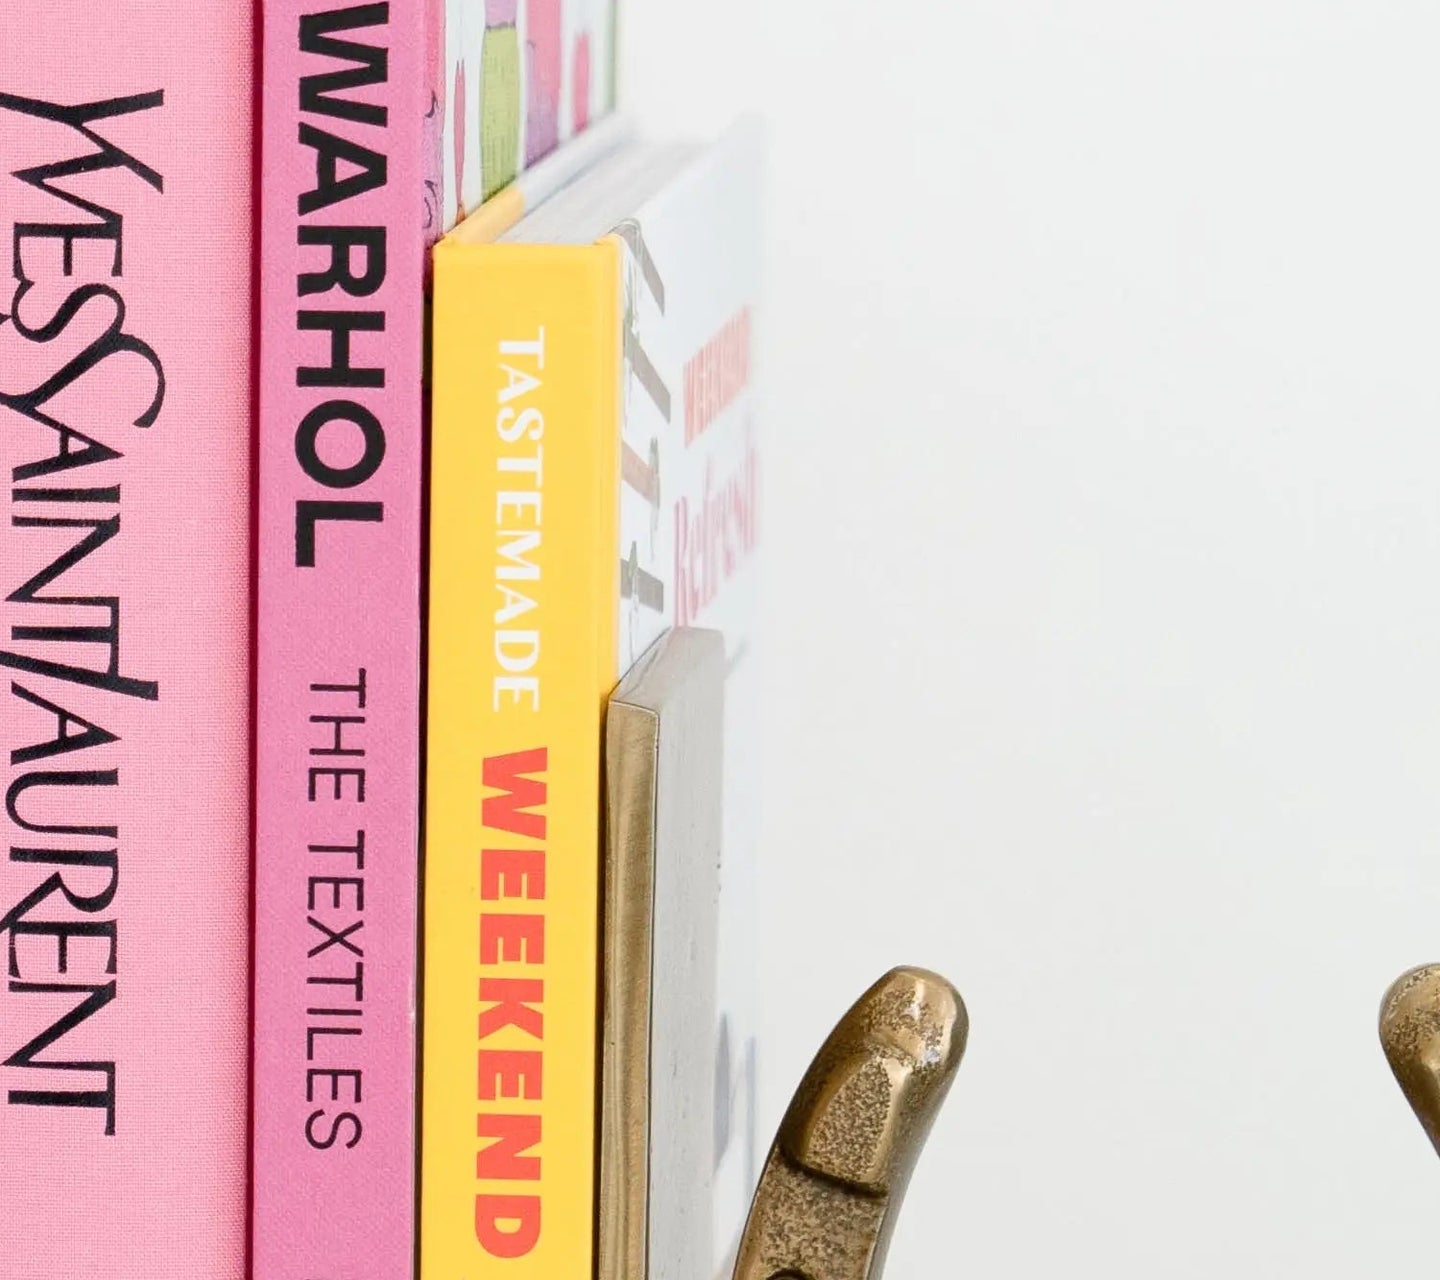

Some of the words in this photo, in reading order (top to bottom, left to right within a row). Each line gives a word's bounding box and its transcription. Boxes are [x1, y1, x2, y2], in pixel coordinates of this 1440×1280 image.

[295, 1, 390, 568] WARHOL
[494, 325, 545, 711] TASTEMADE
[308, 667, 367, 803] THE
[304, 830, 366, 1151] TEXTILES
[475, 747, 548, 1259] WEEKEND
